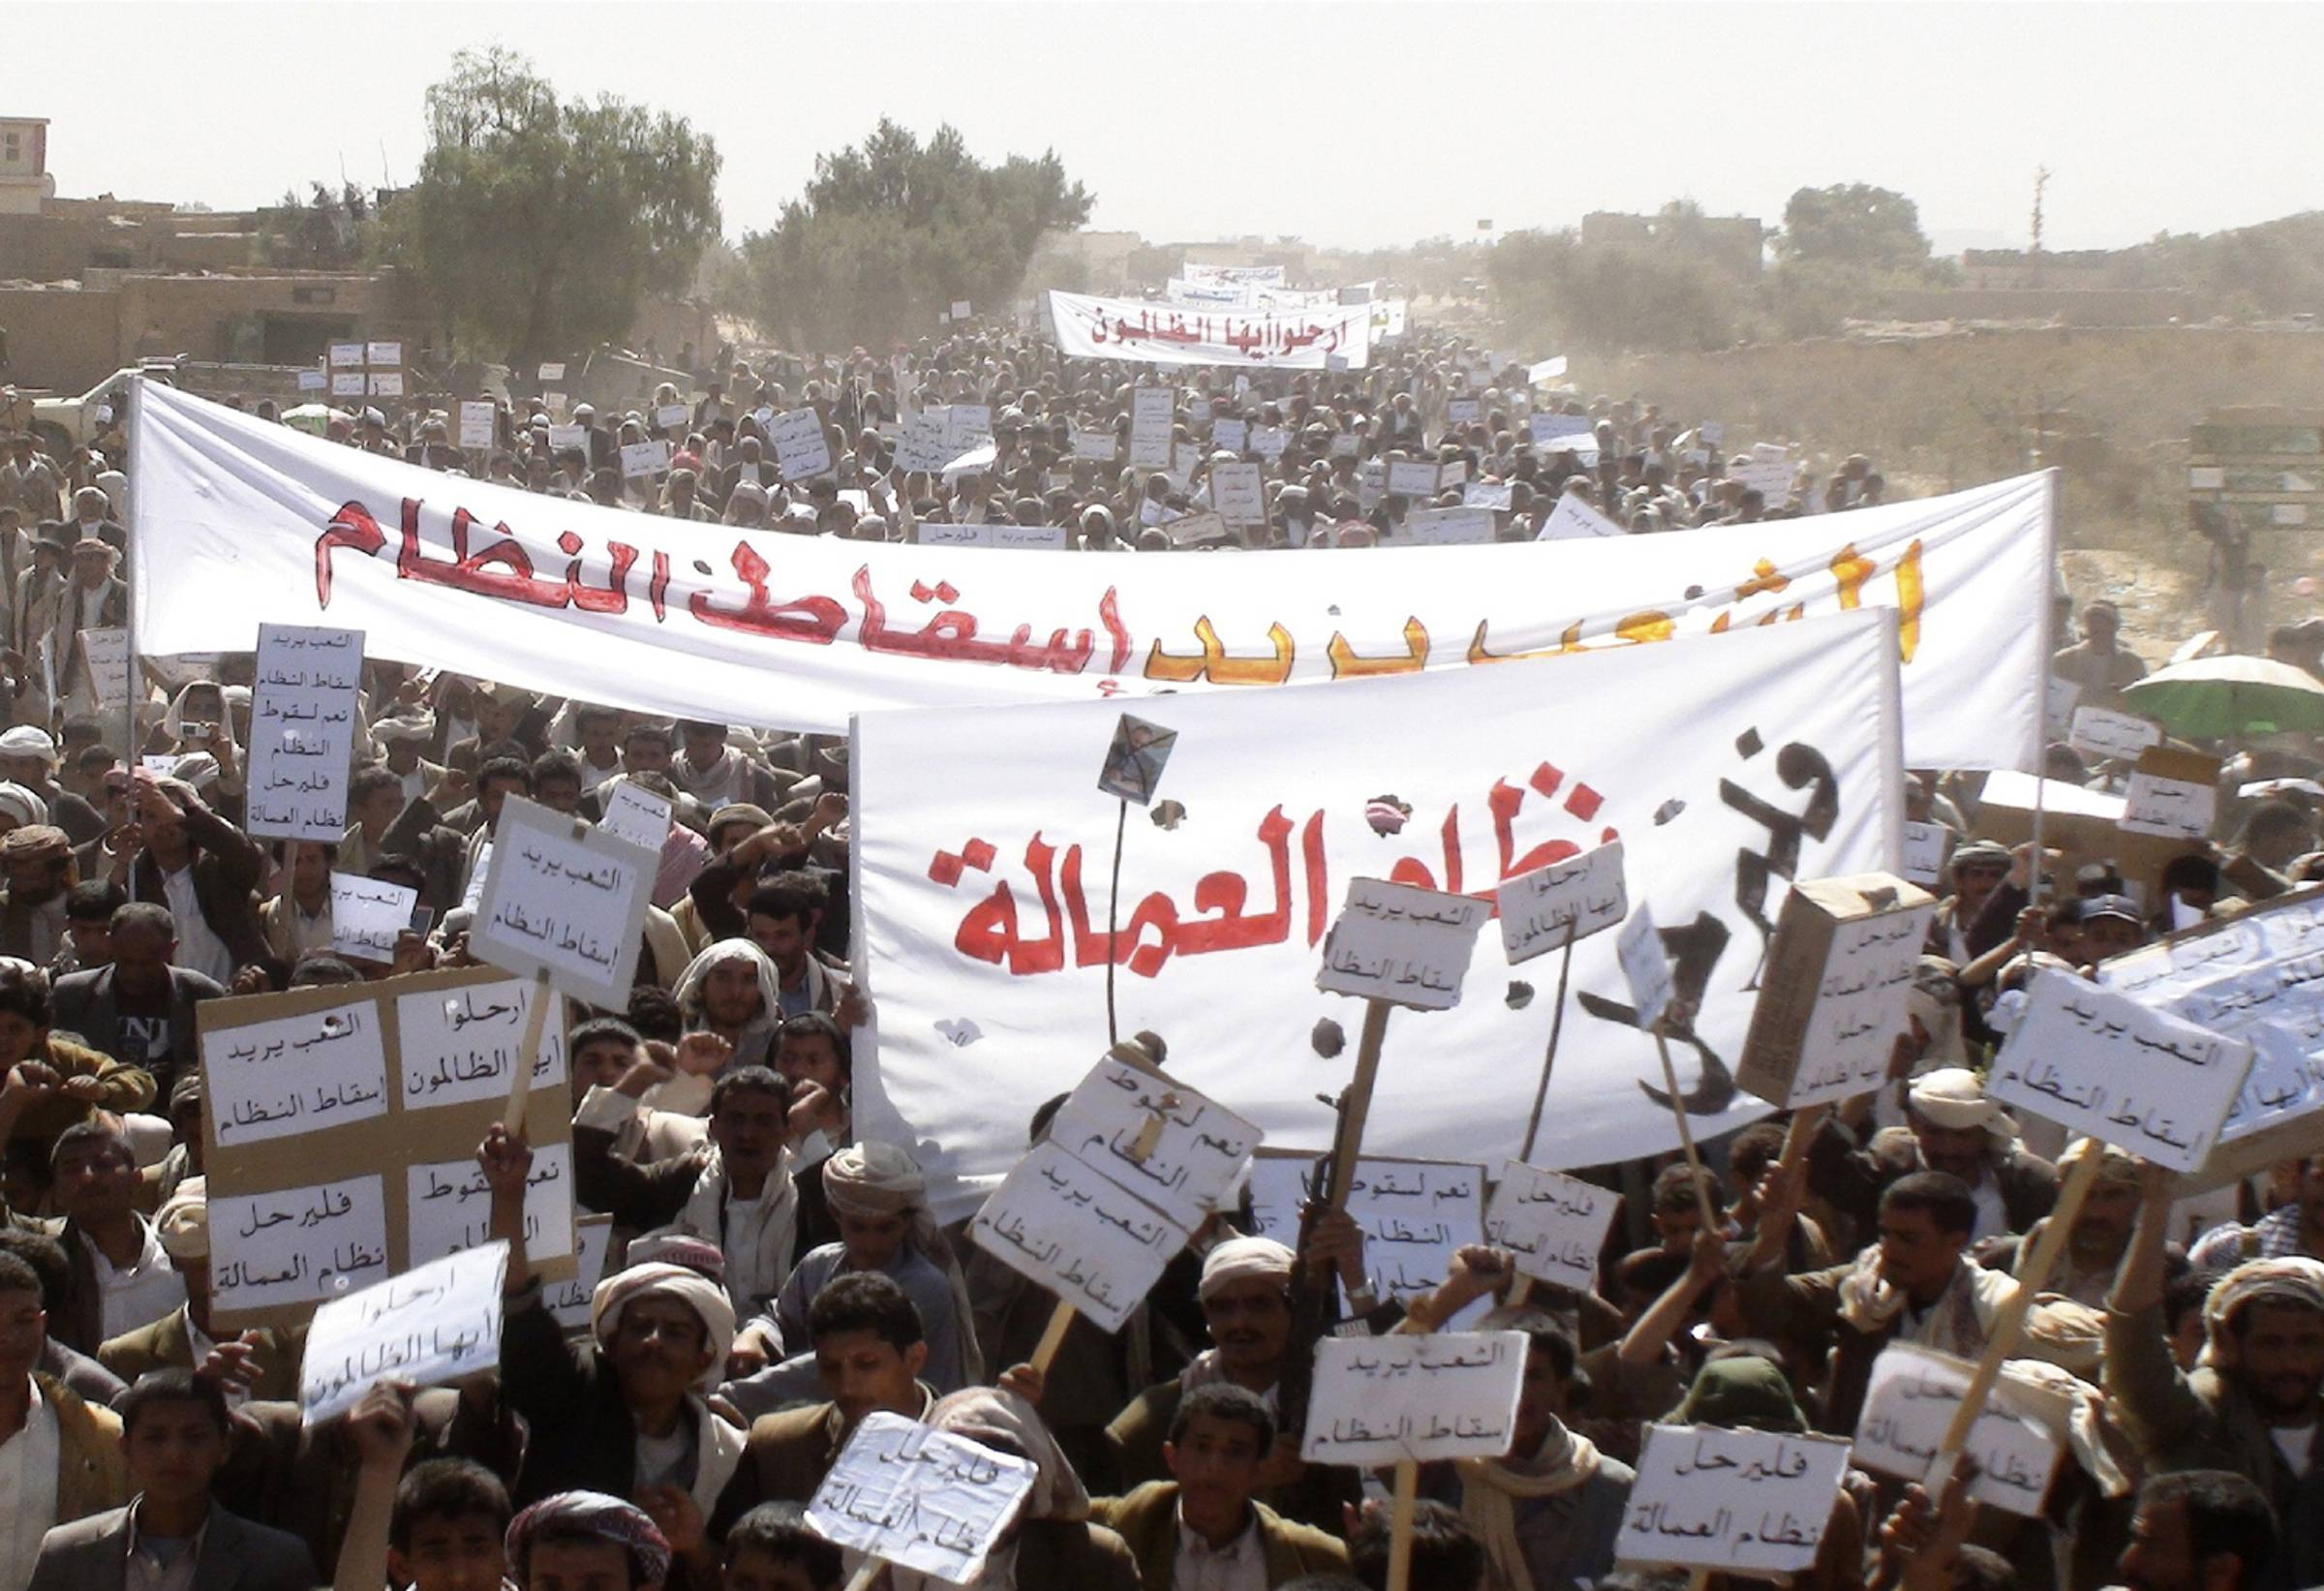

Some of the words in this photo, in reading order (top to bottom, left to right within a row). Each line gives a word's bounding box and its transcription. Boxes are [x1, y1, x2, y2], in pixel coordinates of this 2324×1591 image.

[316, 498, 669, 625] النظام
[689, 541, 1134, 698] إسقاط
[272, 633, 306, 649] يريد
[309, 633, 352, 651] الشعب
[258, 669, 308, 687] النظام
[260, 700, 319, 722] لسقوط
[321, 710, 349, 724] نعم
[271, 737, 331, 762] النظام
[263, 770, 331, 793] فليرحل
[250, 805, 299, 825] العمالة
[302, 808, 345, 833] نظام
[520, 843, 562, 873] يريد
[567, 863, 622, 891] الشعب
[1528, 856, 1594, 897] ارحلوا
[355, 891, 405, 907] الشعب
[928, 803, 1330, 979] العمالة
[1355, 895, 1404, 920] يريد
[490, 902, 555, 942] النظام
[1409, 904, 1474, 927] الشعب
[556, 923, 620, 974] إسقاط
[442, 987, 526, 1032] ارحلوا
[2062, 999, 2126, 1040] يريد
[228, 1039, 286, 1062] يريد
[2132, 1042, 2220, 1068] الشعب
[408, 1049, 508, 1095] الظالمون
[1997, 1058, 2106, 1109] النظام
[312, 1075, 385, 1114] إسقاط
[219, 1091, 305, 1141] النظام
[1189, 1131, 1243, 1158] نعم
[421, 1170, 492, 1204] قوط
[1040, 1164, 1092, 1208] يريد
[1433, 1181, 1472, 1209] نعم
[1517, 1175, 1595, 1217] فليرحل
[240, 1188, 352, 1239] فليرحل
[1094, 1205, 1169, 1250] الشعب
[978, 1210, 1063, 1265] النظام
[1364, 1219, 1451, 1259] النظام
[217, 1252, 309, 1289] العمالة
[318, 1241, 385, 1292] نظام
[361, 1266, 455, 1327] ارحلوا
[308, 1333, 422, 1404] الظالمون
[1347, 1354, 1414, 1379] يريد
[1420, 1341, 1506, 1378] الشعب
[1309, 1415, 1413, 1453] النظام
[879, 1429, 999, 1486] فليرحل
[1675, 1438, 1809, 1482] فليرحل
[822, 1484, 920, 1531] العمالة
[1631, 1502, 1733, 1539] العمالة
[1732, 1510, 1821, 1556] نظام
